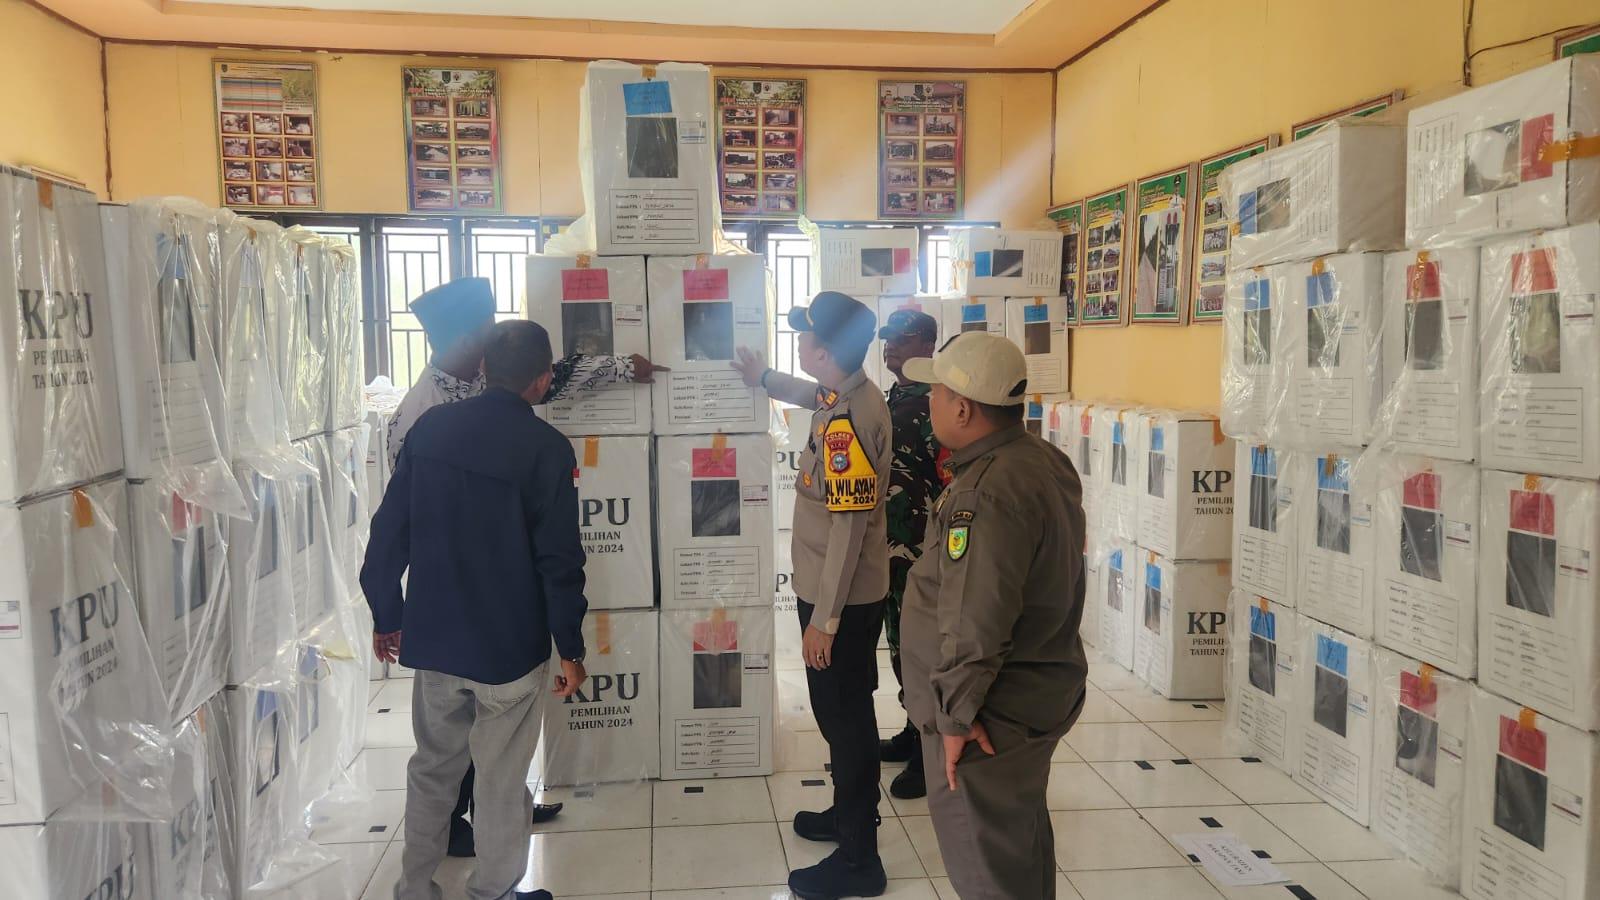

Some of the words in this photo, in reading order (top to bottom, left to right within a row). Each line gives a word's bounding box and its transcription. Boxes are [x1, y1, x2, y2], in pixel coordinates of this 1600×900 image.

[18, 288, 94, 340] KPU
[775, 450, 802, 471] PU
[835, 476, 876, 496] WILAYAH
[1191, 470, 1232, 493] KP
[853, 495, 875, 505] 2024
[1197, 496, 1233, 505] PEMILIH
[580, 497, 631, 527] PU
[1195, 507, 1223, 515] TAHUN
[580, 531, 621, 541] ILIHAN
[597, 544, 624, 553] 2024
[50, 580, 119, 657] KPU
[1187, 611, 1226, 635] KP
[1192, 637, 1225, 646] PEMILIH
[1190, 648, 1218, 656] TAHUN
[563, 672, 641, 704] KPU
[570, 705, 631, 718] PEMILIHAN
[568, 720, 604, 731] TAHUN
[606, 718, 634, 729] 2024
[84, 852, 135, 900] PU
